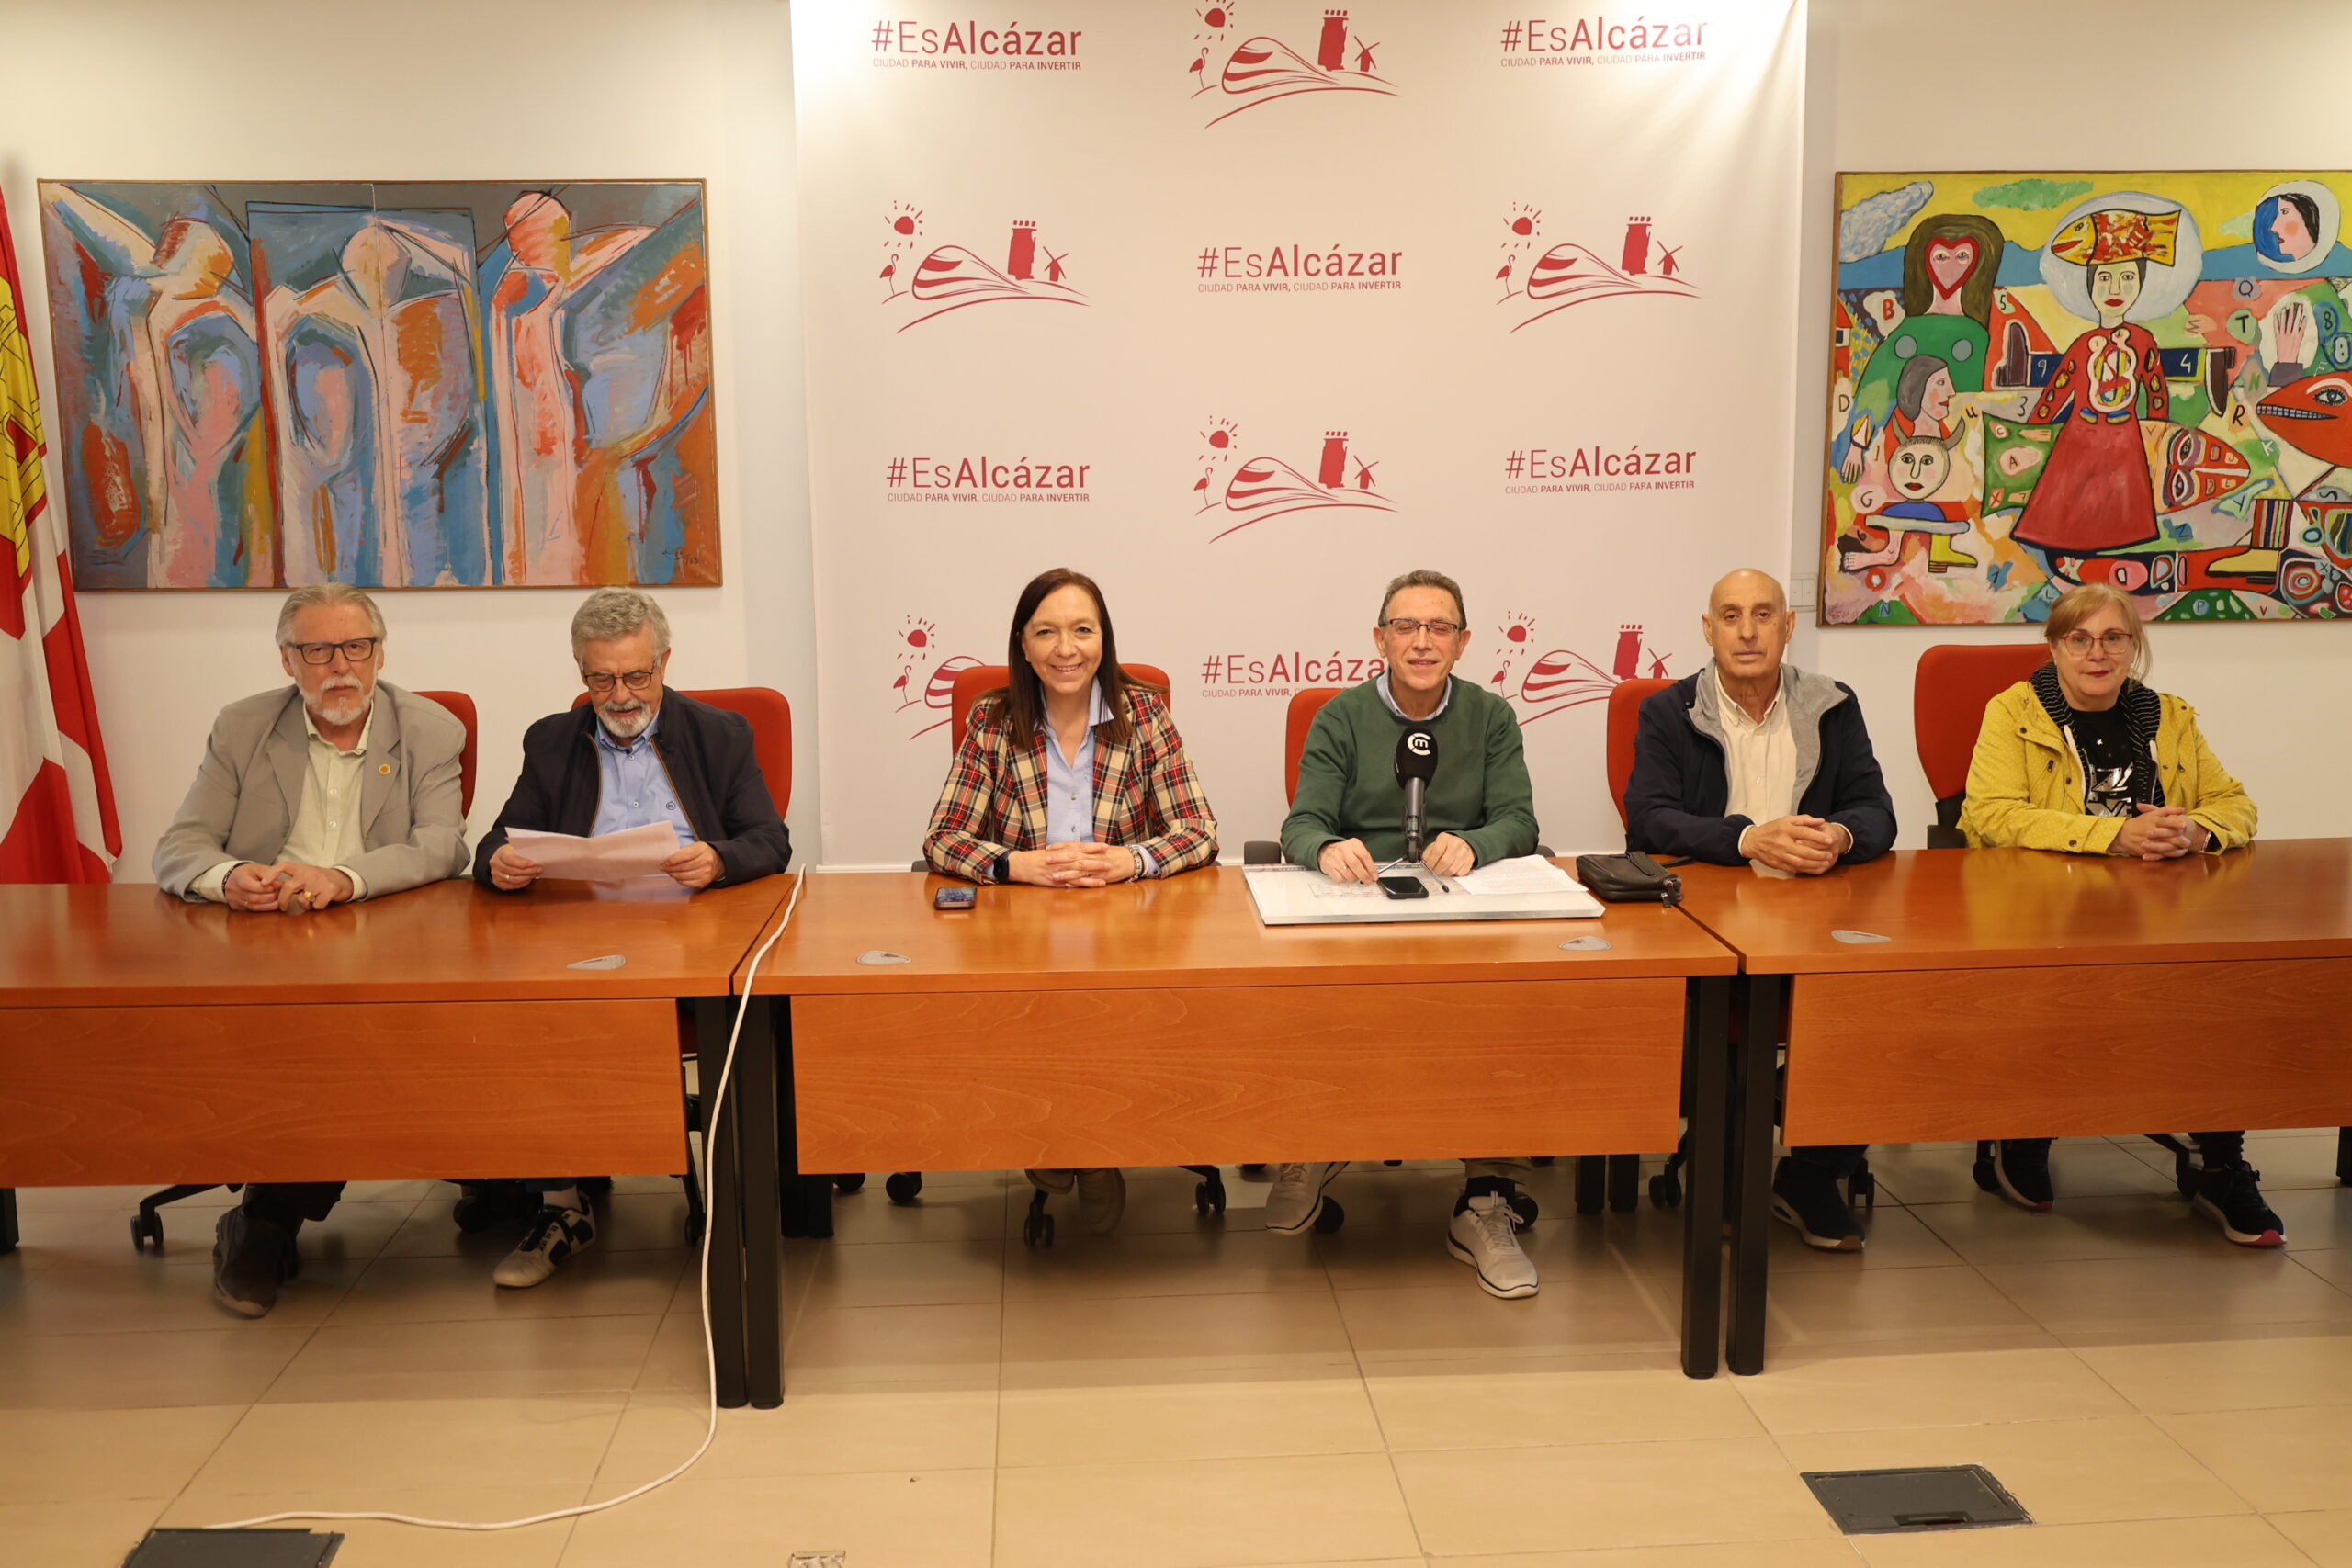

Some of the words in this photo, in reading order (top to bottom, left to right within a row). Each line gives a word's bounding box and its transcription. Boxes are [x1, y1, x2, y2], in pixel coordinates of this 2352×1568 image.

[871, 20, 1082, 56] #EsAlcázar
[1500, 15, 1708, 52] #EsAlcázar
[873, 58, 909, 68] CIUDAD
[911, 60, 937, 69] PARA
[940, 60, 968, 71] VIVIR,
[970, 61, 1007, 70] CIUDAD
[1009, 61, 1035, 71] PARA
[1037, 61, 1081, 71] INVERTIR
[1500, 58, 1537, 68] CIUDAD
[1539, 57, 1564, 66] PARA
[1566, 56, 1595, 67] VIVIR,
[1597, 54, 1633, 65] CIUDAD
[1634, 53, 1660, 63] PARA
[1663, 51, 1706, 62] INVERTIR
[1197, 243, 1403, 278] #EsAlcázar
[1198, 283, 1233, 293] CIUDAD
[1236, 283, 1261, 292] PARA
[1263, 282, 1291, 293] VIVIR,
[1293, 282, 1329, 292] CIUDAD
[1330, 281, 1355, 290] PARA
[1358, 280, 1401, 290] INVERTIR
[2238, 280, 2253, 298] Q
[1883, 299, 1895, 321] B
[1999, 294, 2007, 310] 5
[2234, 314, 2249, 333] T
[2324, 310, 2333, 330] 8
[2037, 359, 2048, 379] 9
[2180, 353, 2192, 374] 4
[2248, 373, 2261, 391] N
[1838, 394, 1850, 412] D
[2017, 396, 2029, 417] 3
[2232, 405, 2245, 426] R
[2261, 440, 2274, 457] K
[1505, 445, 1697, 479] #EsAlcázar
[2008, 455, 2018, 470] A
[886, 456, 1090, 489] #EsAlcázar
[1505, 485, 1538, 495] CIUDAD
[1540, 484, 1564, 493] PARA
[1566, 483, 1592, 493] VIVIR,
[1594, 482, 1627, 492] CIUDAD
[1629, 482, 1653, 491] PARA
[1655, 480, 1695, 490] INVERTIR
[888, 492, 922, 502] CIUDAD
[924, 493, 950, 502] PARA
[952, 493, 980, 503] VIVIR,
[981, 493, 1017, 502] CIUDAD
[1020, 493, 1045, 502] PARA
[1046, 493, 1090, 502] INVERTIR
[1860, 491, 1873, 507] G
[1857, 529, 1867, 541] 6
[2175, 524, 2190, 537] Z
[2045, 590, 2054, 600] L
[2196, 600, 2206, 613] P
[1201, 650, 1386, 684] #EsAlcáza
[1202, 689, 1237, 698] CIUDAD
[1239, 688, 1263, 697] PARA
[1266, 687, 1293, 698] VIVIR,
